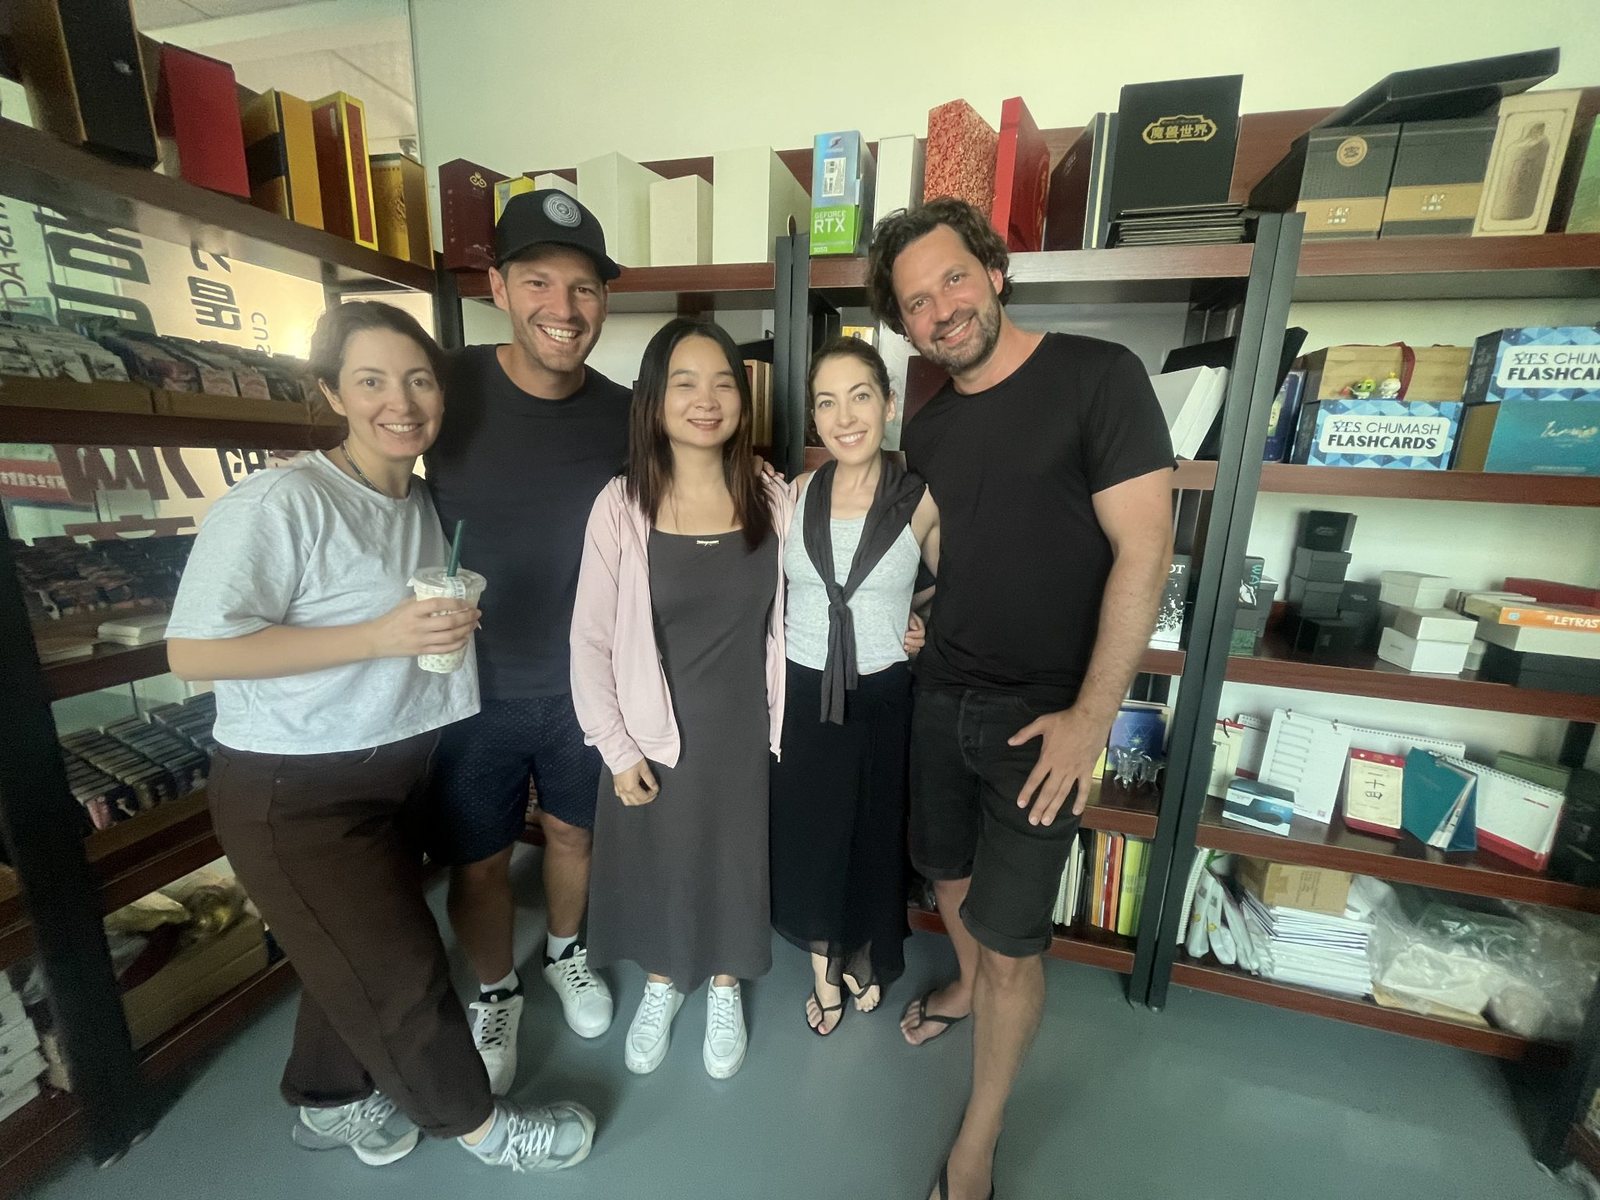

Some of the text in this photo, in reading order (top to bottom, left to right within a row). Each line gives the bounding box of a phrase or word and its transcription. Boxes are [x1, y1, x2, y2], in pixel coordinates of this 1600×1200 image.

[814, 217, 845, 234] RTX
[1333, 420, 1441, 435] YES CHUMASH
[1327, 434, 1437, 450] FLASHCARDS
